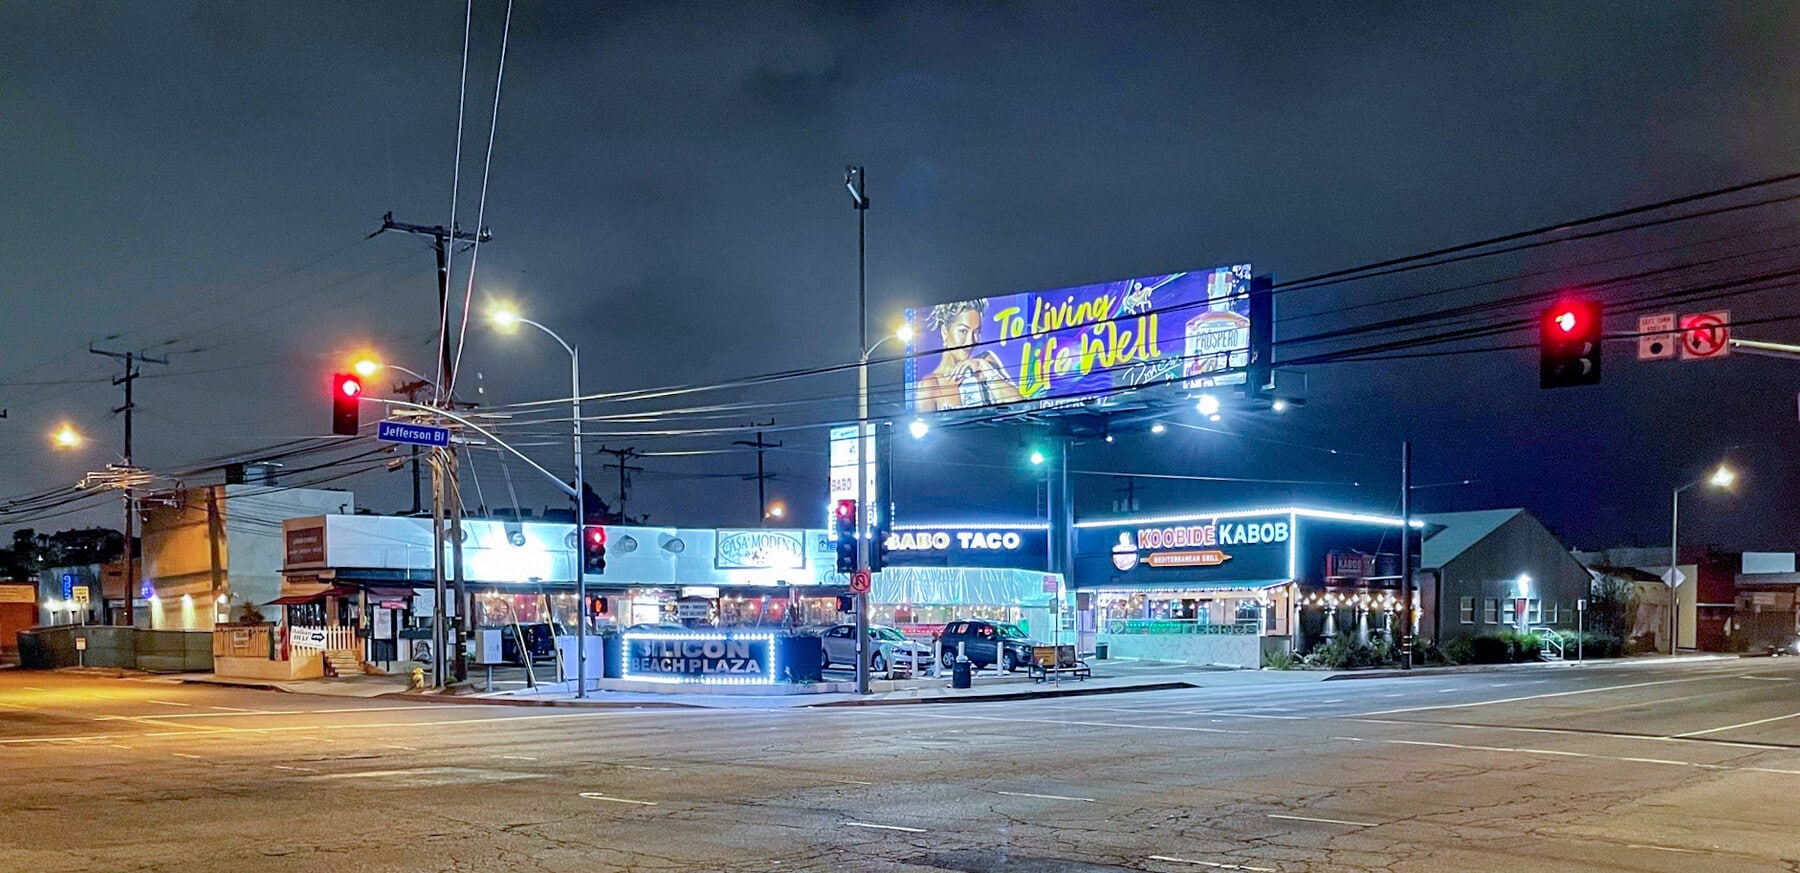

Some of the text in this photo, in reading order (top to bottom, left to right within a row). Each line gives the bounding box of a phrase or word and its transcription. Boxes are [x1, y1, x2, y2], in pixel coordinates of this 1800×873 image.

[994, 295, 1116, 346] To Living
[1019, 336, 1072, 398] Life
[1079, 313, 1161, 376] Well
[383, 426, 445, 441] Jefferson Bl
[831, 478, 852, 491] BABO
[884, 532, 1020, 550] BABO TACO
[1138, 522, 1289, 549] KOOBIDE KABOB
[722, 537, 748, 556] CASA
[1153, 554, 1219, 564] MEDITERRANEAN GRILL
[638, 640, 750, 658] SILICON
[632, 658, 761, 673] BEACH PLAZA
